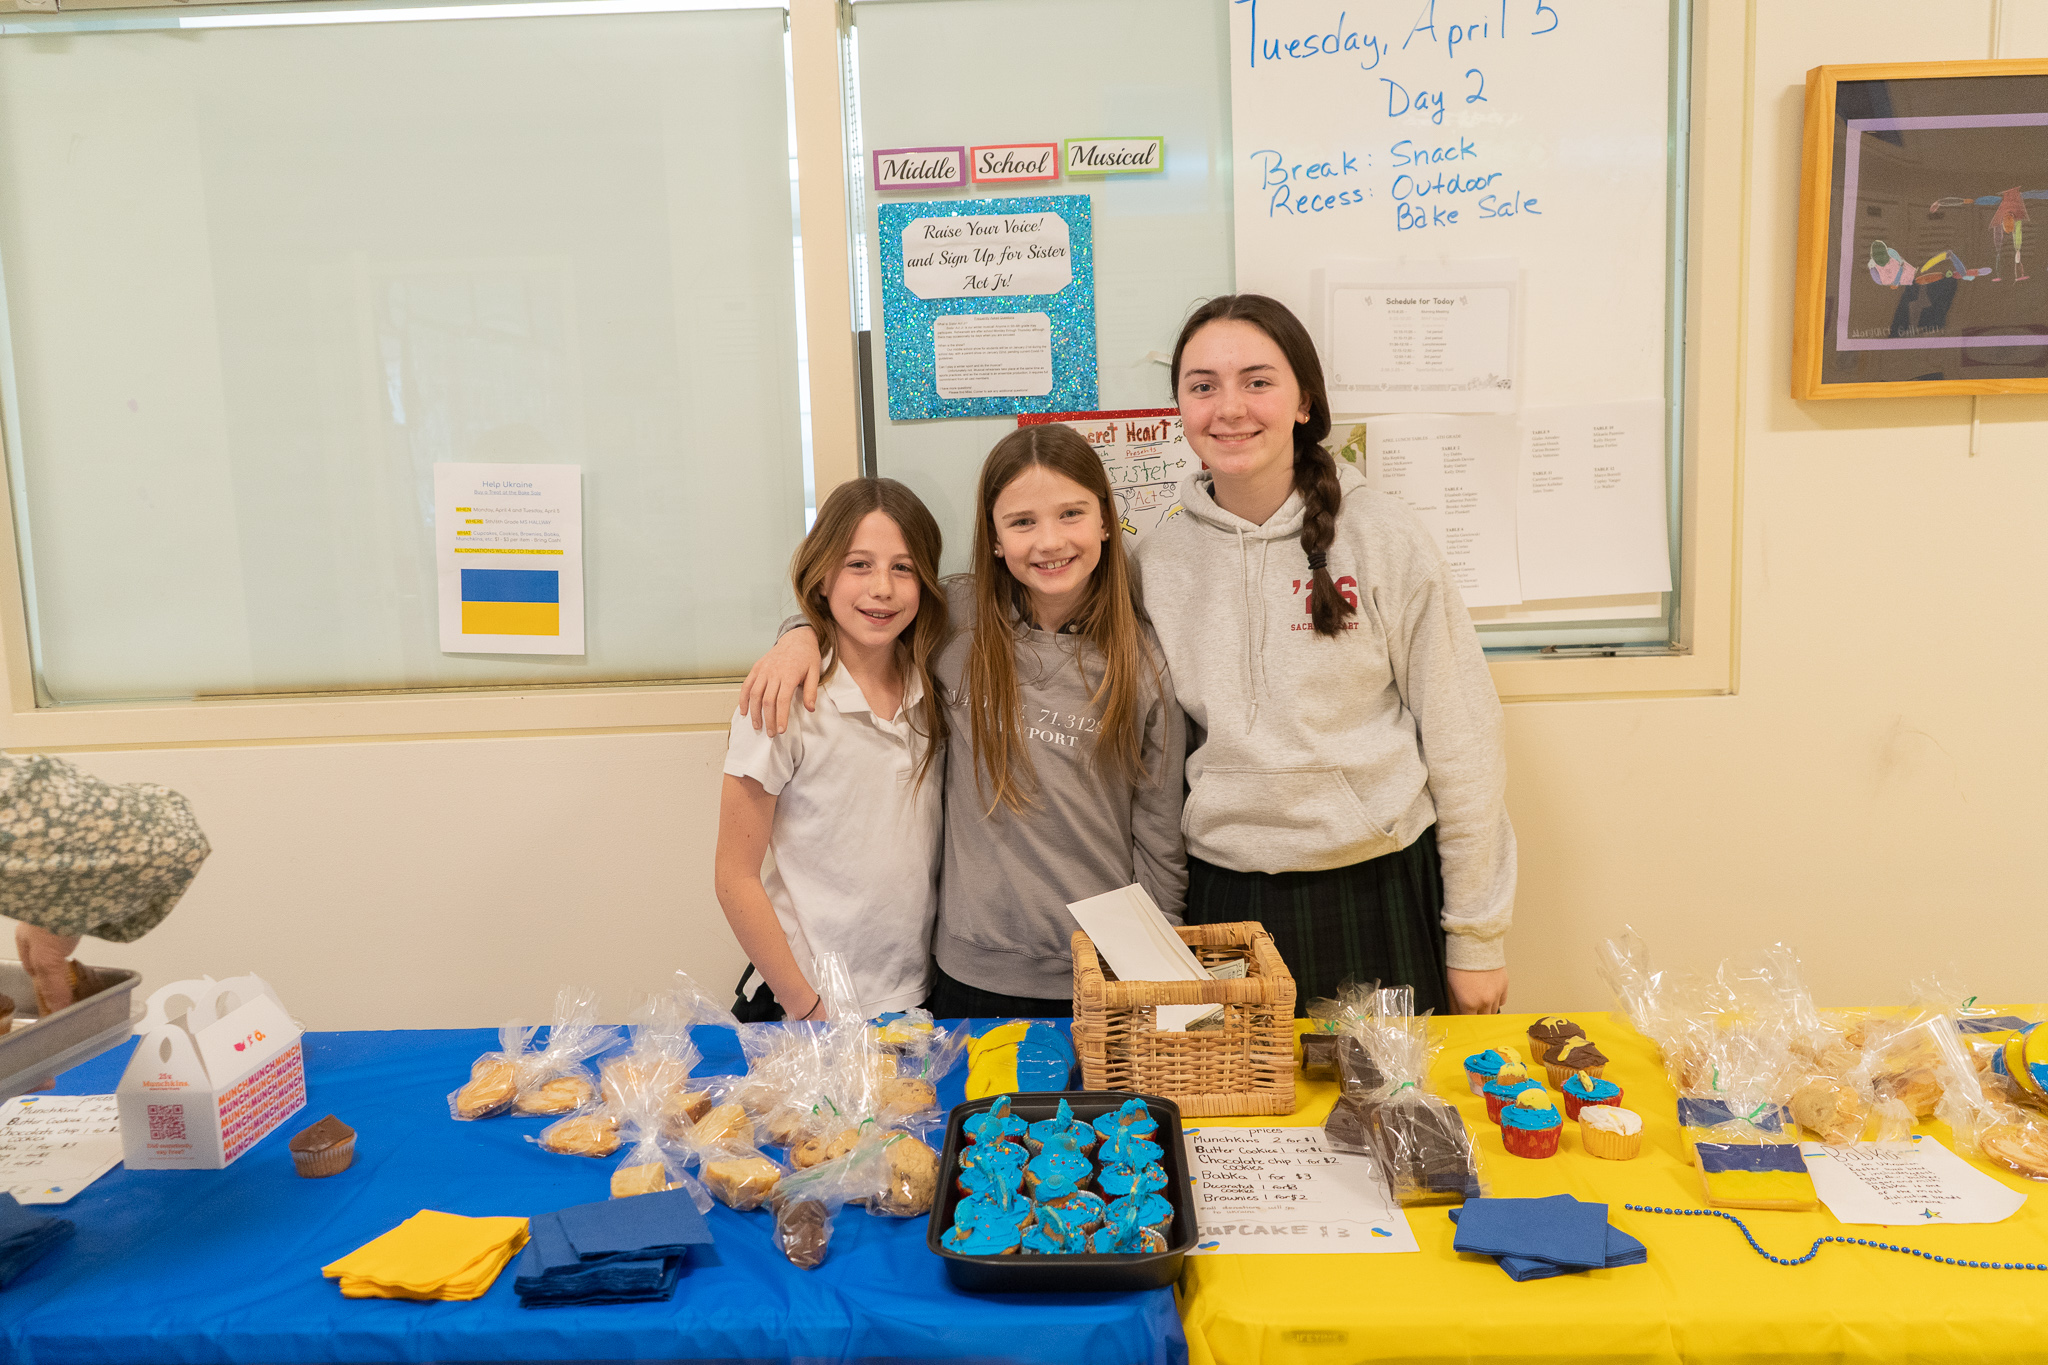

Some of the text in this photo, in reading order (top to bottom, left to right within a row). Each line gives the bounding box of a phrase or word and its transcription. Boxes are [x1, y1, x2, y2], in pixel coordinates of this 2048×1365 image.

[1235, 0, 1558, 70] Tuesday, April 5
[1379, 68, 1488, 125] Day 2
[977, 150, 1051, 175] School
[1070, 142, 1158, 168] Musical
[1250, 136, 1478, 190] Break: Snack
[882, 156, 957, 181] Middle
[1269, 171, 1503, 218] Recess: Outdoor
[1396, 189, 1543, 232] Bake Sale
[922, 218, 1044, 240] Raise Your Voice!
[906, 244, 1067, 269] and Sign Up for Sister
[962, 273, 1012, 291] Act Jr!
[1386, 297, 1455, 306] Schedule for Today
[1125, 419, 1171, 443] Heart
[1125, 447, 1157, 458] Presents
[1108, 460, 1174, 484] Sister
[482, 481, 501, 489] Help
[1134, 490, 1158, 506] Act
[1249, 1128, 1283, 1137] prices
[1198, 1154, 1265, 1164] Chocolate
[1204, 1194, 1259, 1202] Brownies
